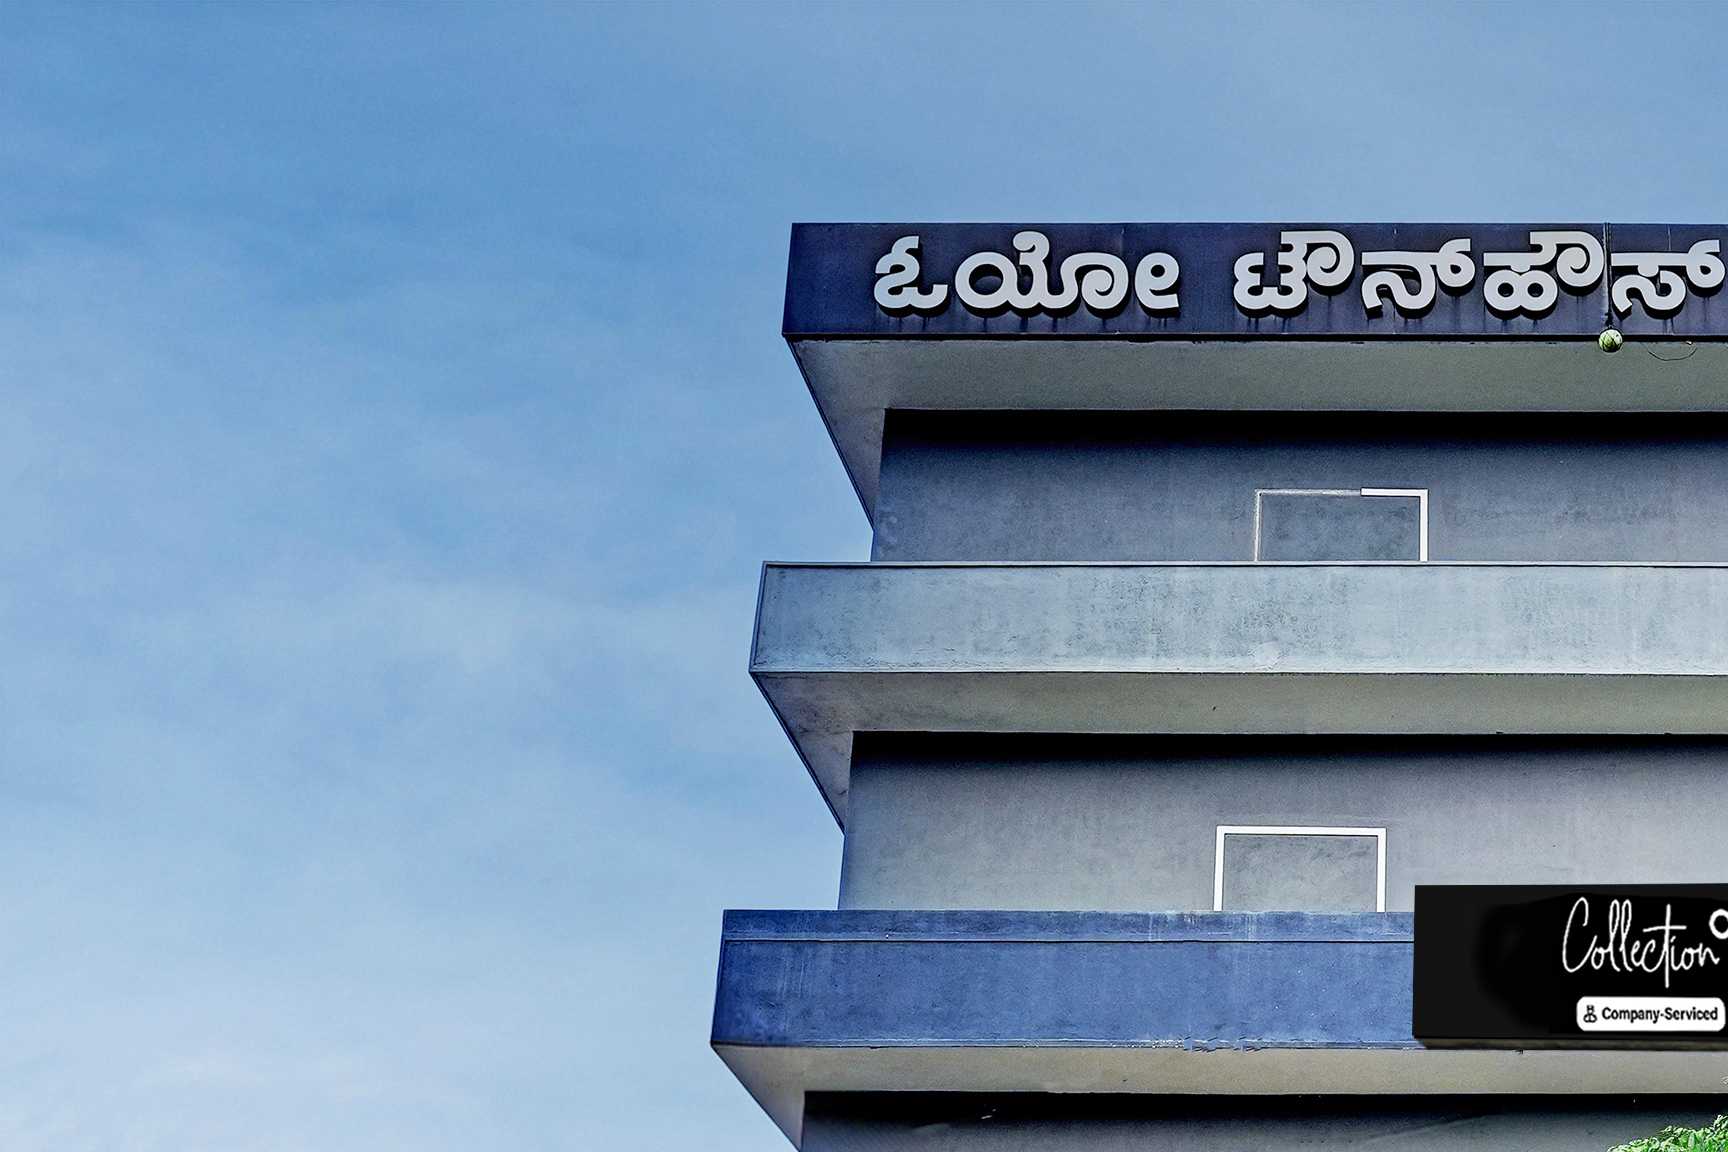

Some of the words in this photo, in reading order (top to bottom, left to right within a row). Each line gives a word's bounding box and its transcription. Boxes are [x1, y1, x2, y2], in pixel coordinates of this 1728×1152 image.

[874, 231, 1180, 311] ಓಯೋ
[1562, 897, 1720, 988] Collection
[1601, 1006, 1718, 1024] Company-Serviced
